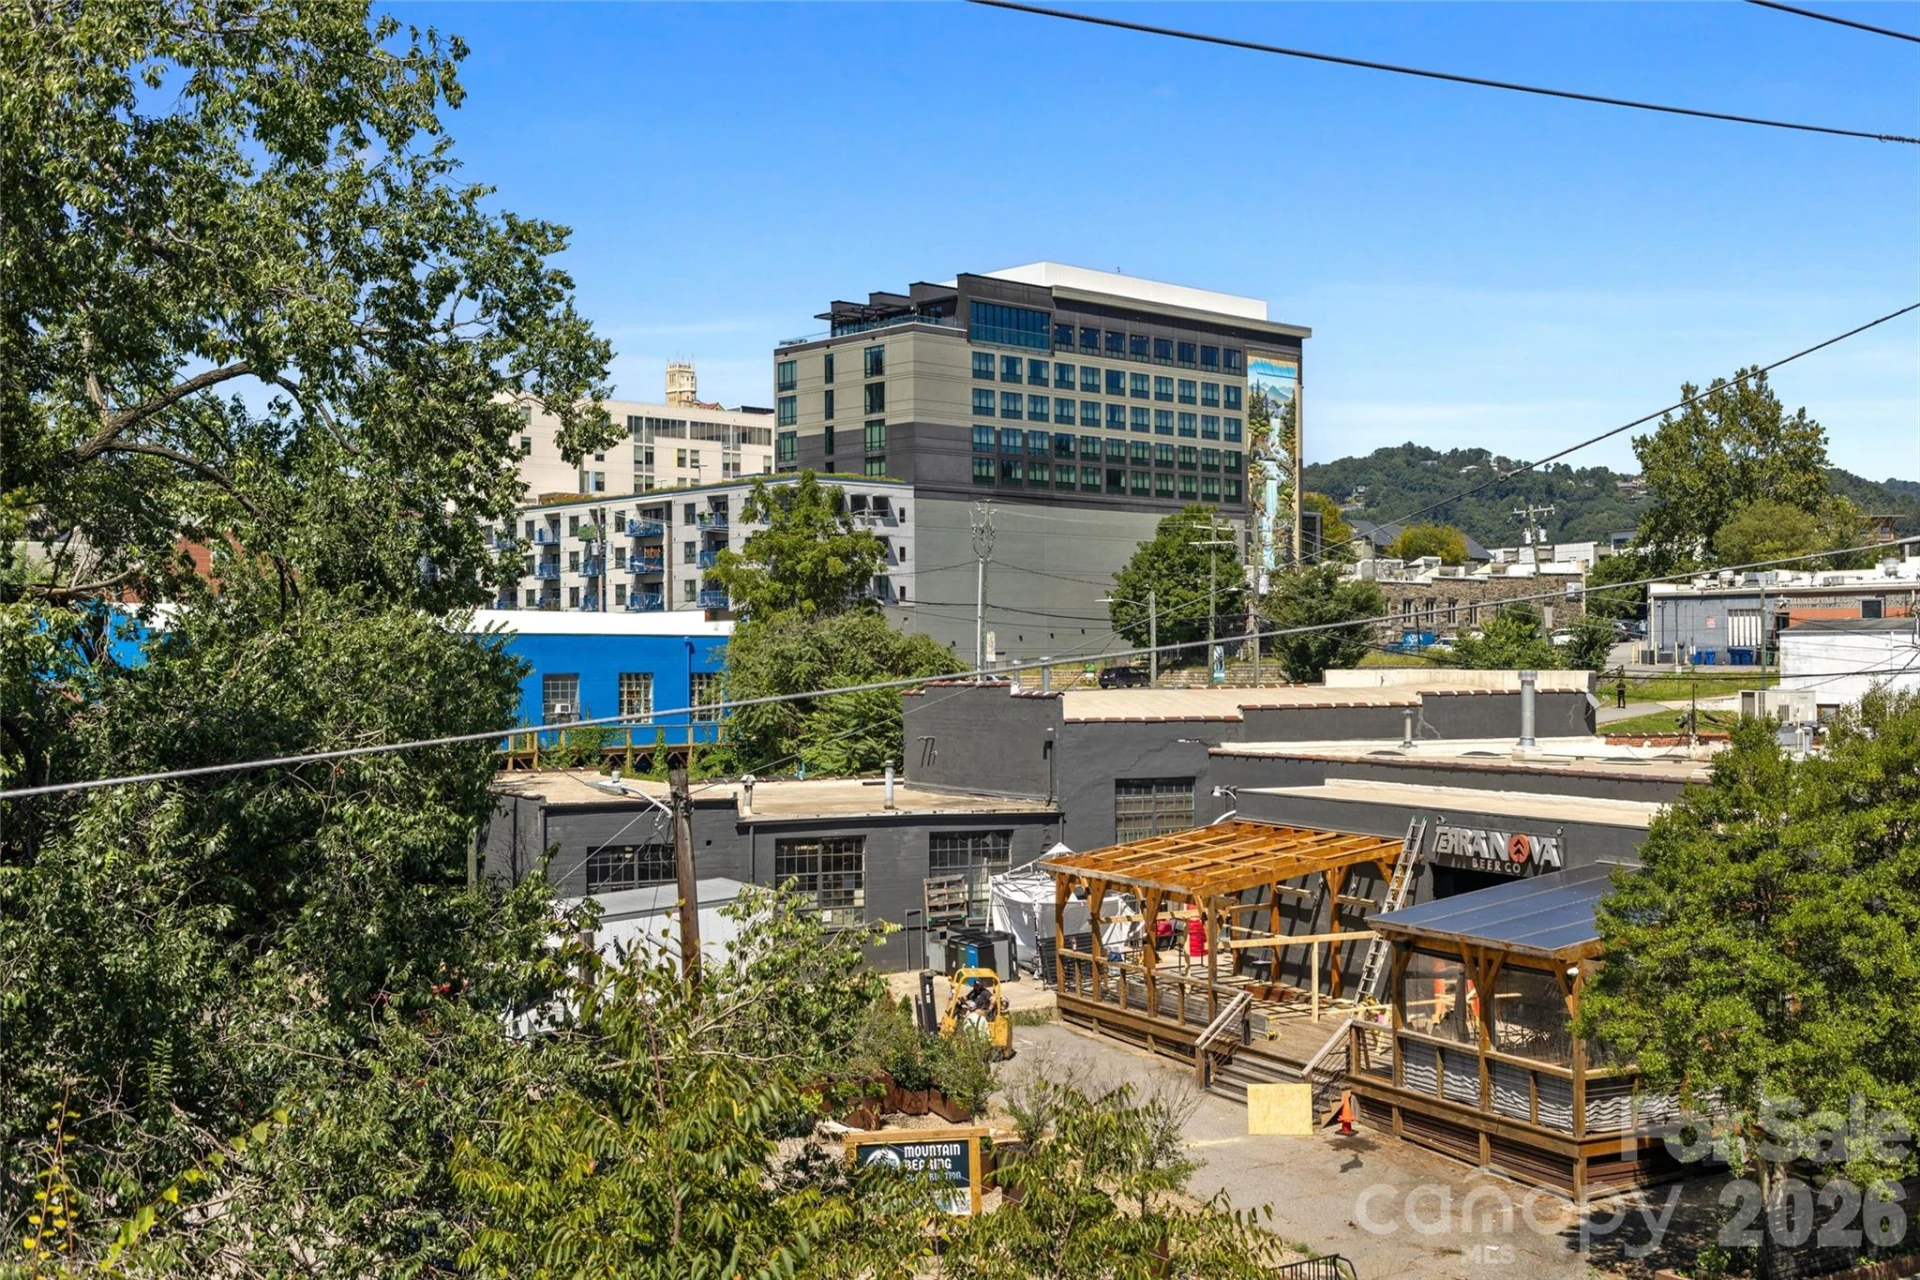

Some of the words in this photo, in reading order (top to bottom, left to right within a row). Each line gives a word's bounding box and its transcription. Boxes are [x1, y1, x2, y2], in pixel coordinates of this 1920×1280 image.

[1472, 858, 1501, 871] BEER
[1505, 862, 1521, 874] CO
[904, 1144, 961, 1157] MOUNTAIN
